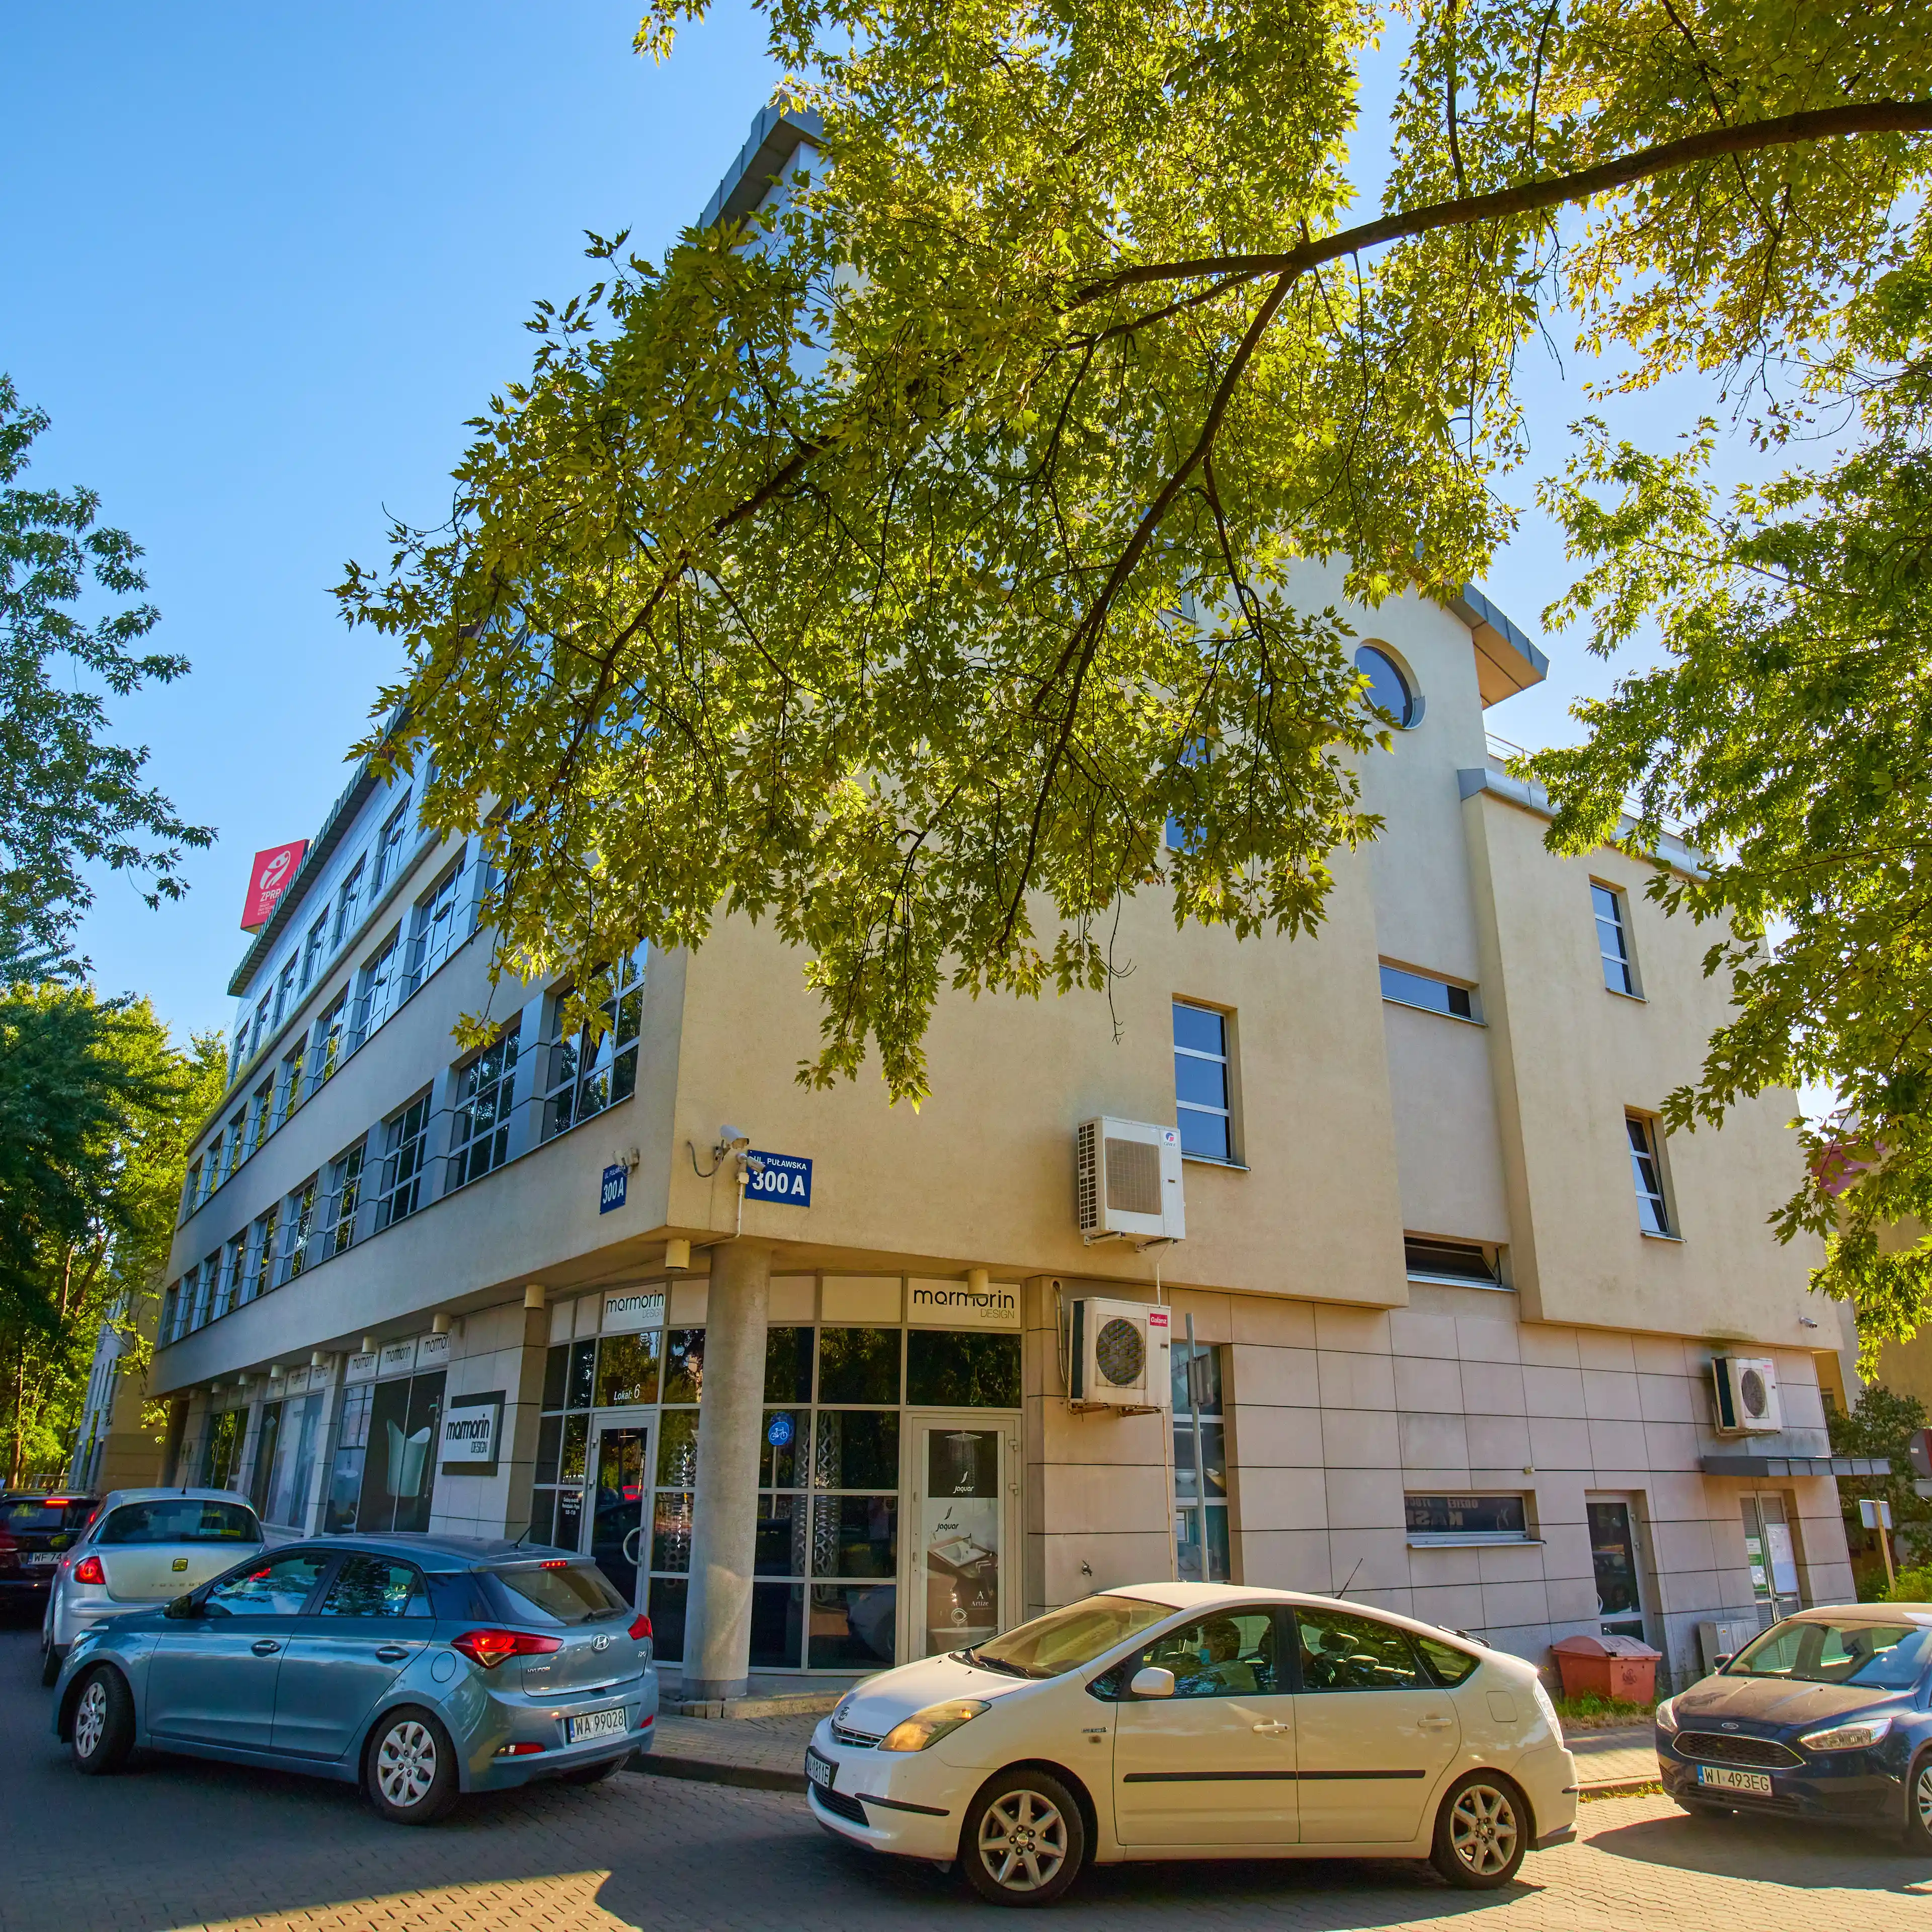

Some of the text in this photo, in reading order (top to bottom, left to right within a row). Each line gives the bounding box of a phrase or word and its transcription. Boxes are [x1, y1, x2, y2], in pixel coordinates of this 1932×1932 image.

[767, 1158, 807, 1170] PUŁAWSKA
[603, 1177, 624, 1203] 300 A
[752, 1171, 806, 1196] 300 A
[606, 1290, 664, 1313] marmorin
[914, 1290, 1014, 1309] marmorin
[642, 1308, 663, 1318] DESIGN
[981, 1308, 1014, 1319] DESIGN
[614, 1384, 640, 1401] Lokal: 6
[446, 1413, 490, 1440] marmorin
[471, 1441, 488, 1454] DESIGN
[34, 1553, 48, 1562] WF
[527, 1666, 550, 1674] HYUNDAI
[576, 1717, 591, 1736] WA
[594, 1710, 624, 1732] 99028
[1705, 1767, 1720, 1784] WI
[1728, 1772, 1769, 1791] 493EG
